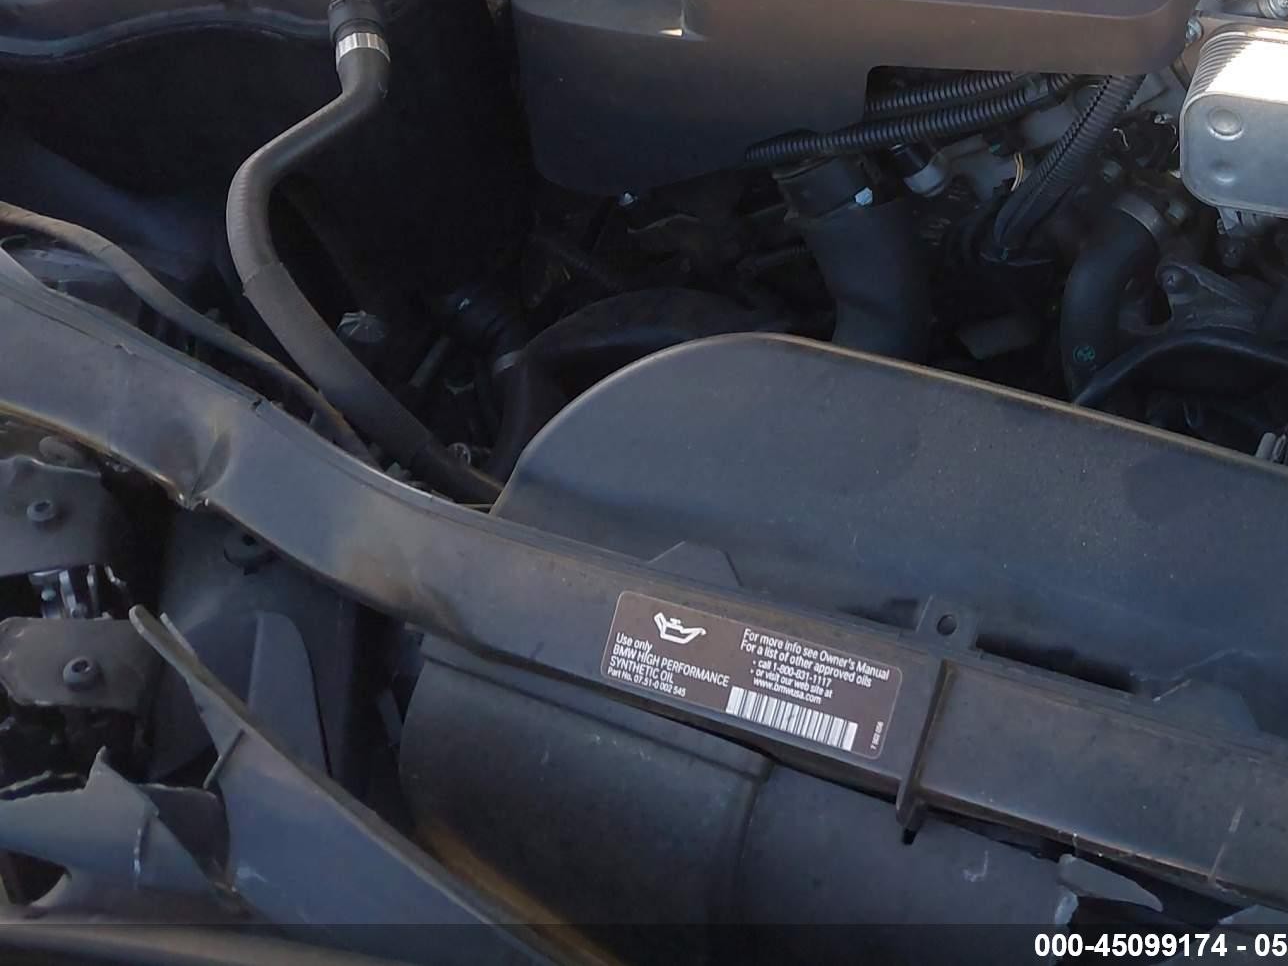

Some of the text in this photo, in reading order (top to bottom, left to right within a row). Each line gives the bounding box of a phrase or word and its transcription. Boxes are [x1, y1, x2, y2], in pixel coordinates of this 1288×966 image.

[616, 633, 652, 655] Use only
[744, 628, 890, 680] For more info see Owner's Manual
[610, 655, 674, 684] SYNTHETIC OIL
[613, 644, 730, 687] BMW HIGH PERFORMANCE
[741, 639, 872, 687] For a list of other approved oils
[758, 659, 832, 687] call 1-800-831-1117
[608, 667, 621, 678] Part
[622, 670, 633, 682] No.
[660, 683, 673, 693] 002
[673, 687, 686, 697] 545
[753, 678, 822, 704] www.bmwusa.com
[756, 668, 833, 698] or visit our web site at
